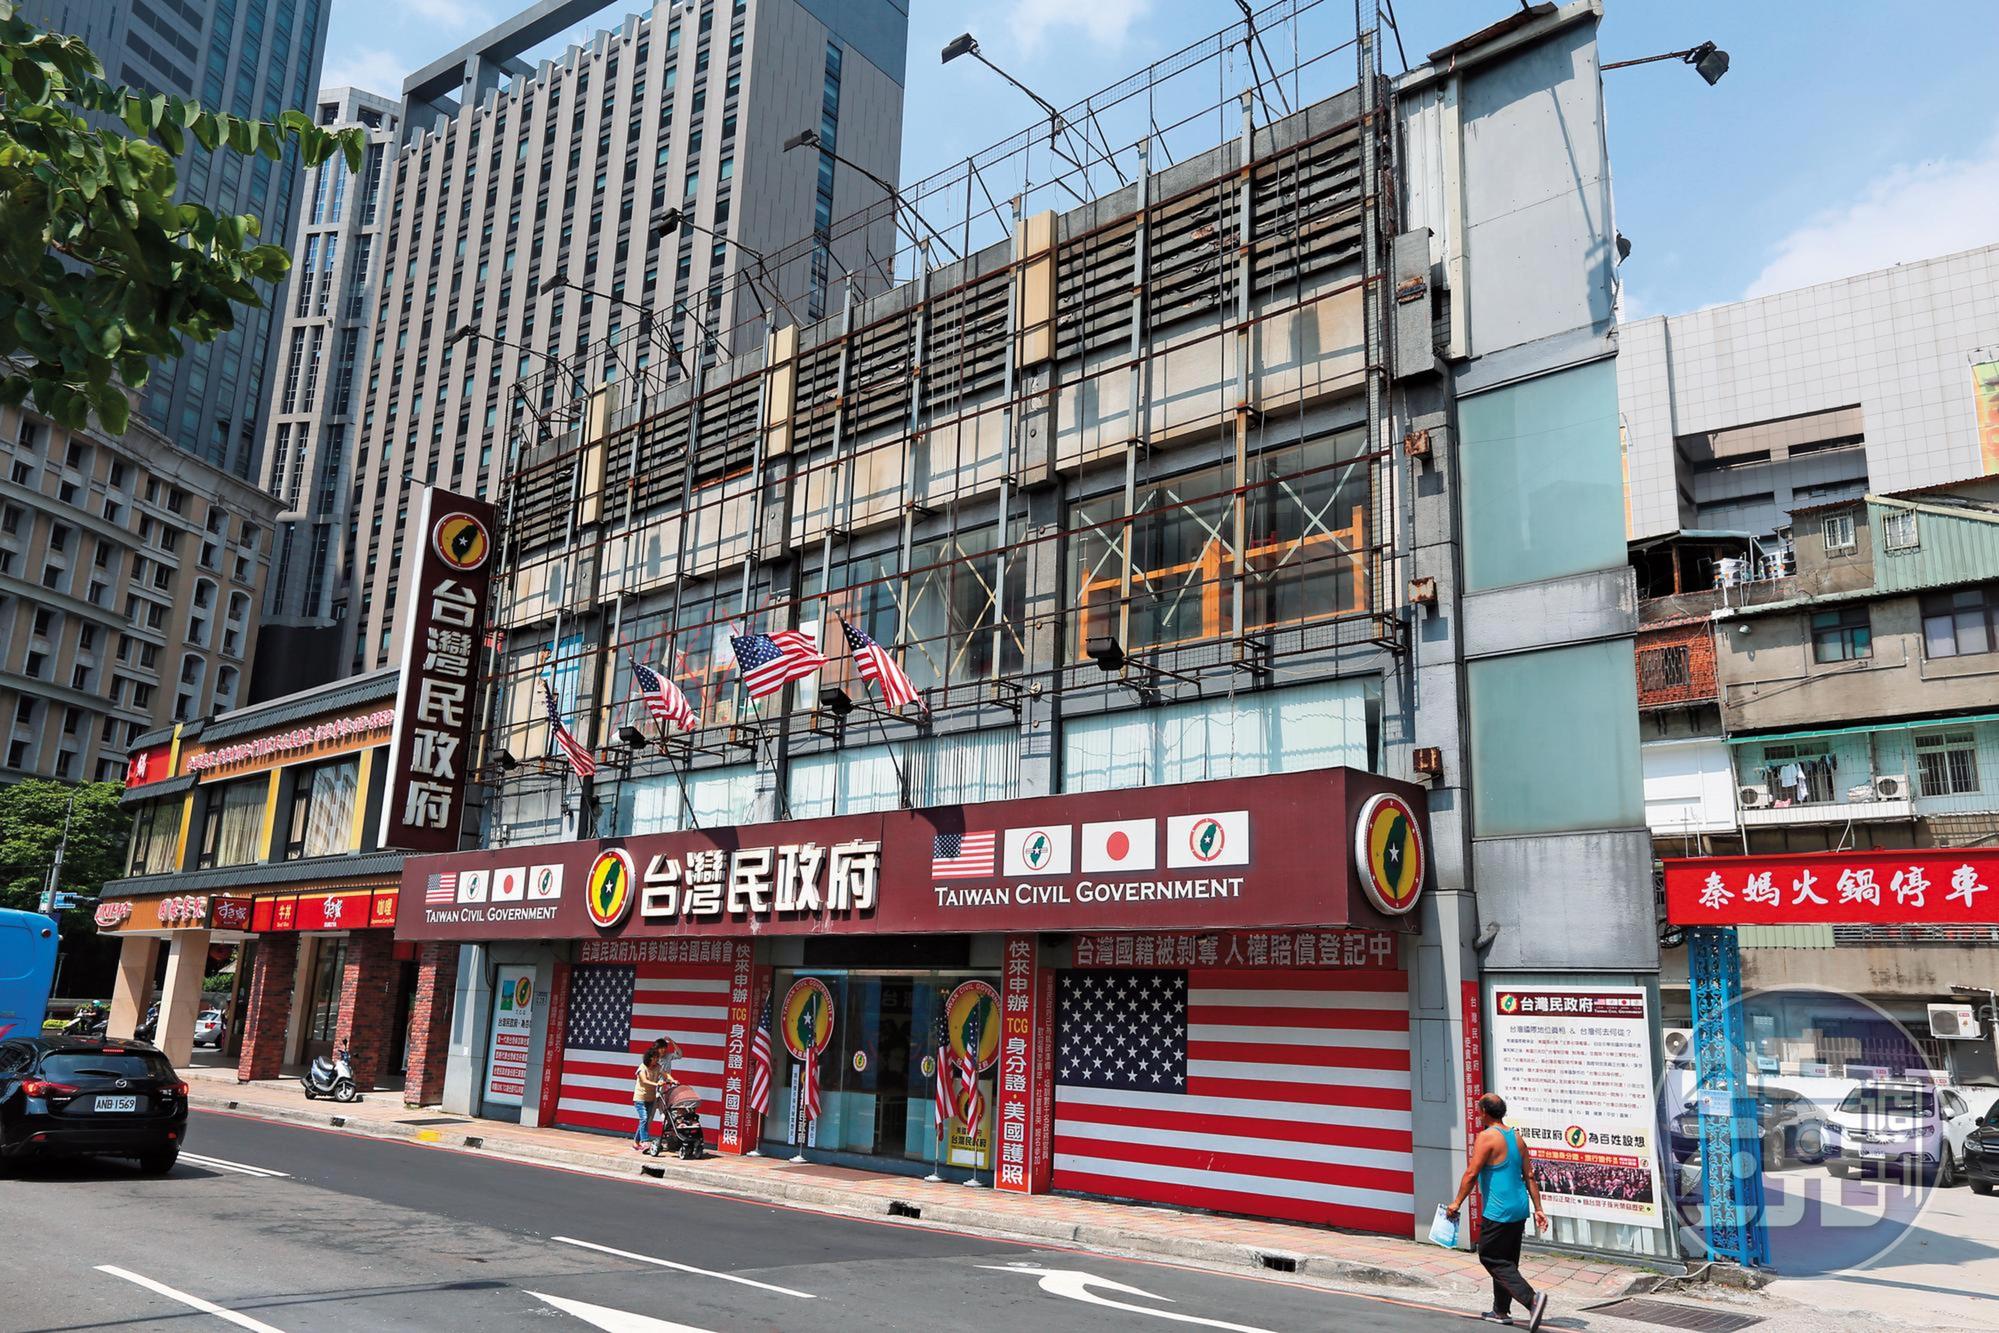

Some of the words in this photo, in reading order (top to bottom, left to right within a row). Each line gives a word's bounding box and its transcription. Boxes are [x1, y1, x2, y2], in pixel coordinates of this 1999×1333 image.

[401, 578, 478, 829] 台灣民政府
[640, 838, 881, 918] 台灣民政府
[934, 886, 1010, 907] TAIWAN
[1015, 883, 1071, 904] CIVIL
[1075, 877, 1245, 902] GOVERNMENT
[425, 909, 460, 923] TAIWAN
[460, 907, 485, 922] CIVIL
[487, 906, 558, 921] GOVERNMENT
[1520, 995, 1595, 1013] 台灣民政府
